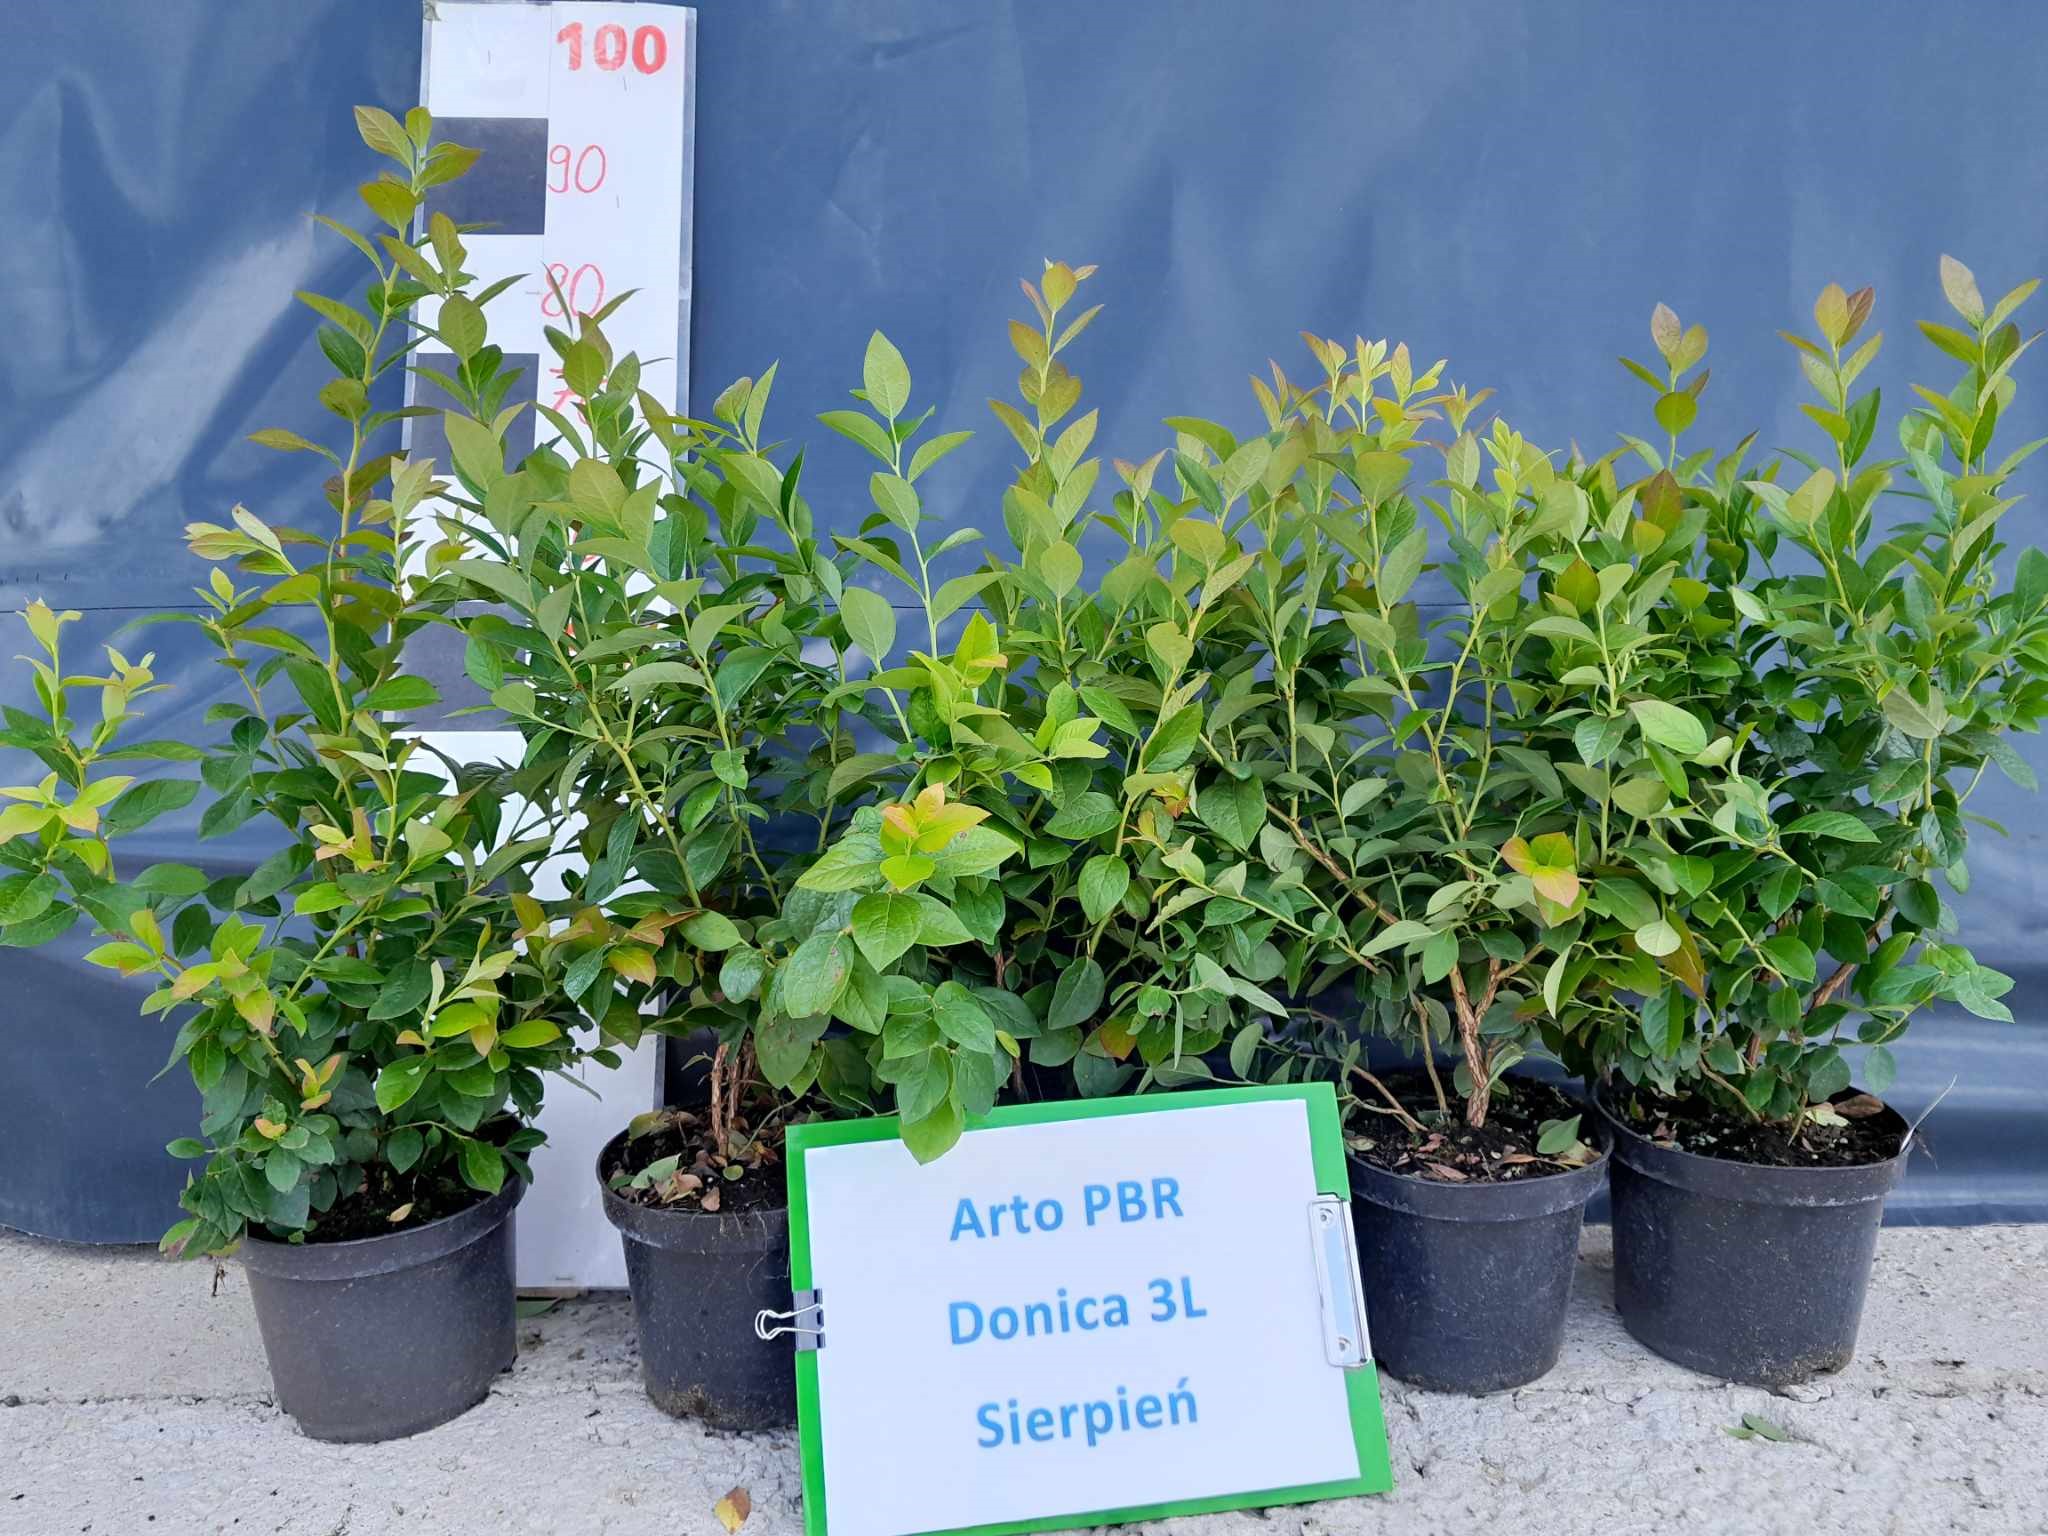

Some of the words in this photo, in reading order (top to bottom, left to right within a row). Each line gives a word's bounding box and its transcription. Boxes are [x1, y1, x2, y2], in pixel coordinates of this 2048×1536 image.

[555, 21, 669, 75] 100
[547, 144, 607, 194] 90
[540, 262, 606, 318] 80
[949, 1193, 1065, 1243] Arto
[1082, 1175, 1185, 1227] PBR
[947, 1287, 1131, 1346] Donica
[1146, 1275, 1209, 1323] 3L
[975, 1376, 1199, 1450] Sierpień
